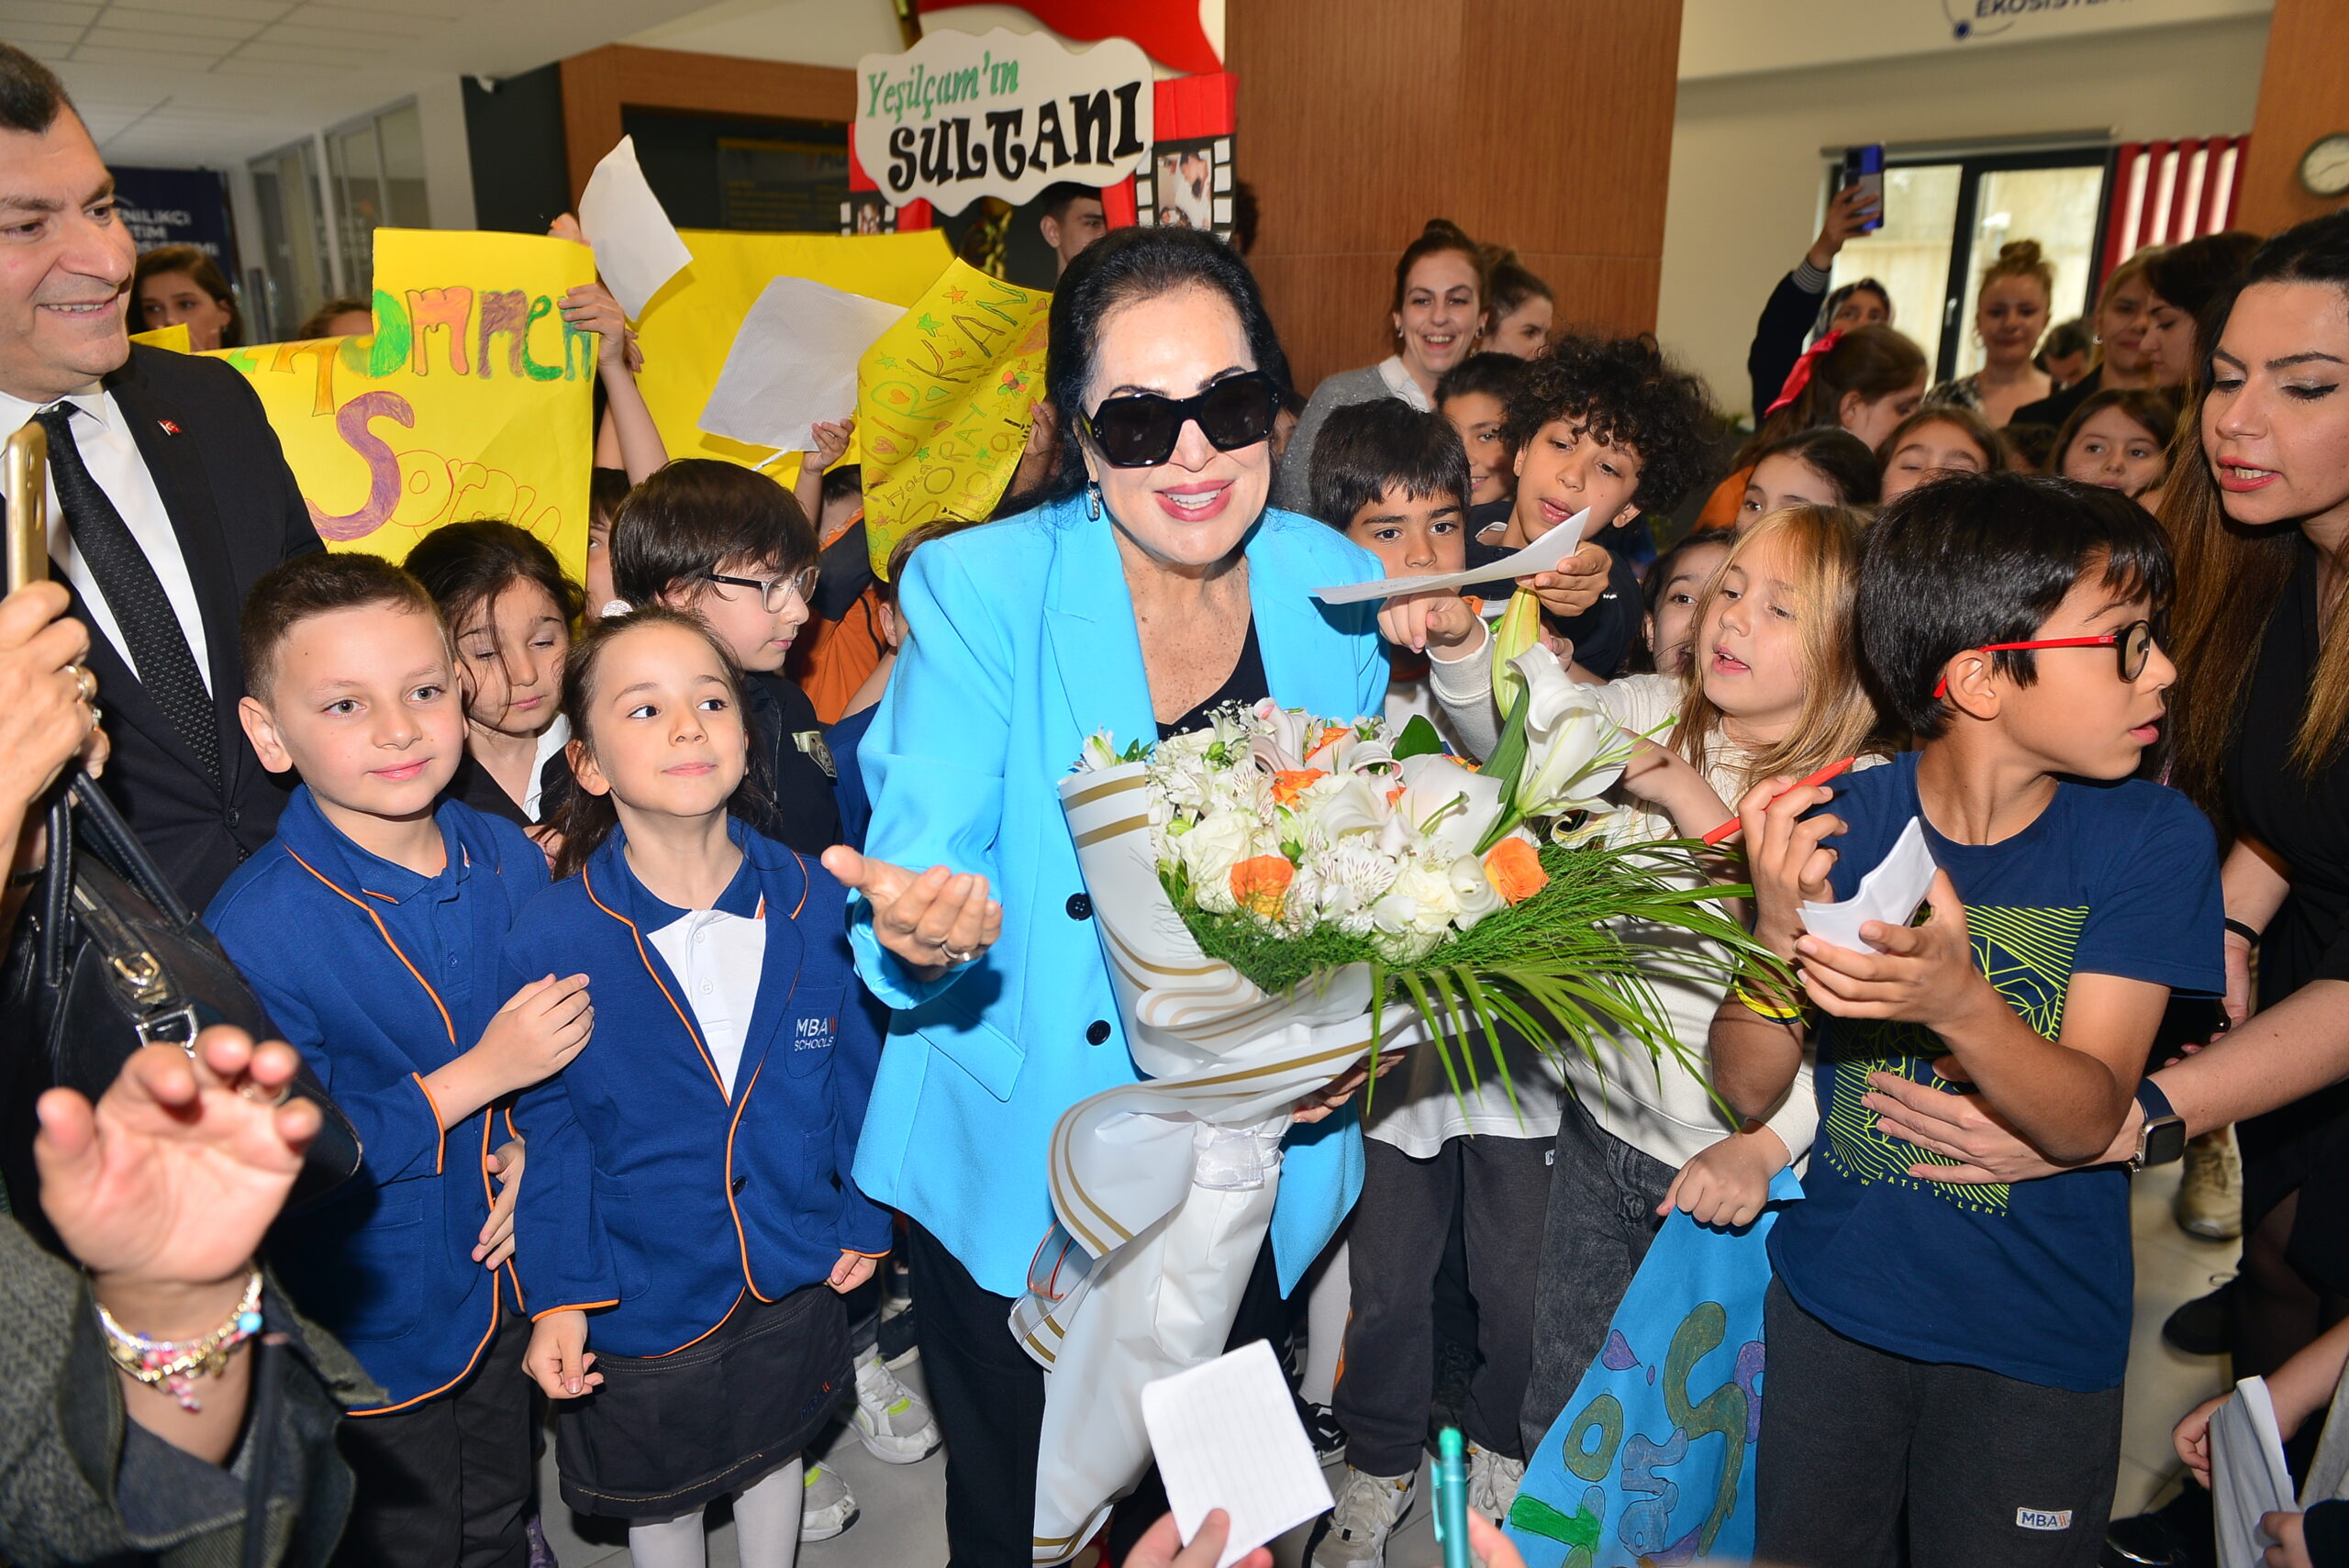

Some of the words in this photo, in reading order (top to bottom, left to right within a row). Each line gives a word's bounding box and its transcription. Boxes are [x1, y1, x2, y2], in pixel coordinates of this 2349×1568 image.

[867, 50, 1019, 123] Yeşilçam'ın
[795, 1017, 828, 1038] MBA
[794, 1036, 834, 1051] SCHOOLS
[1822, 1150, 1850, 1179] HARD
[2021, 1511, 2058, 1528] MBA
